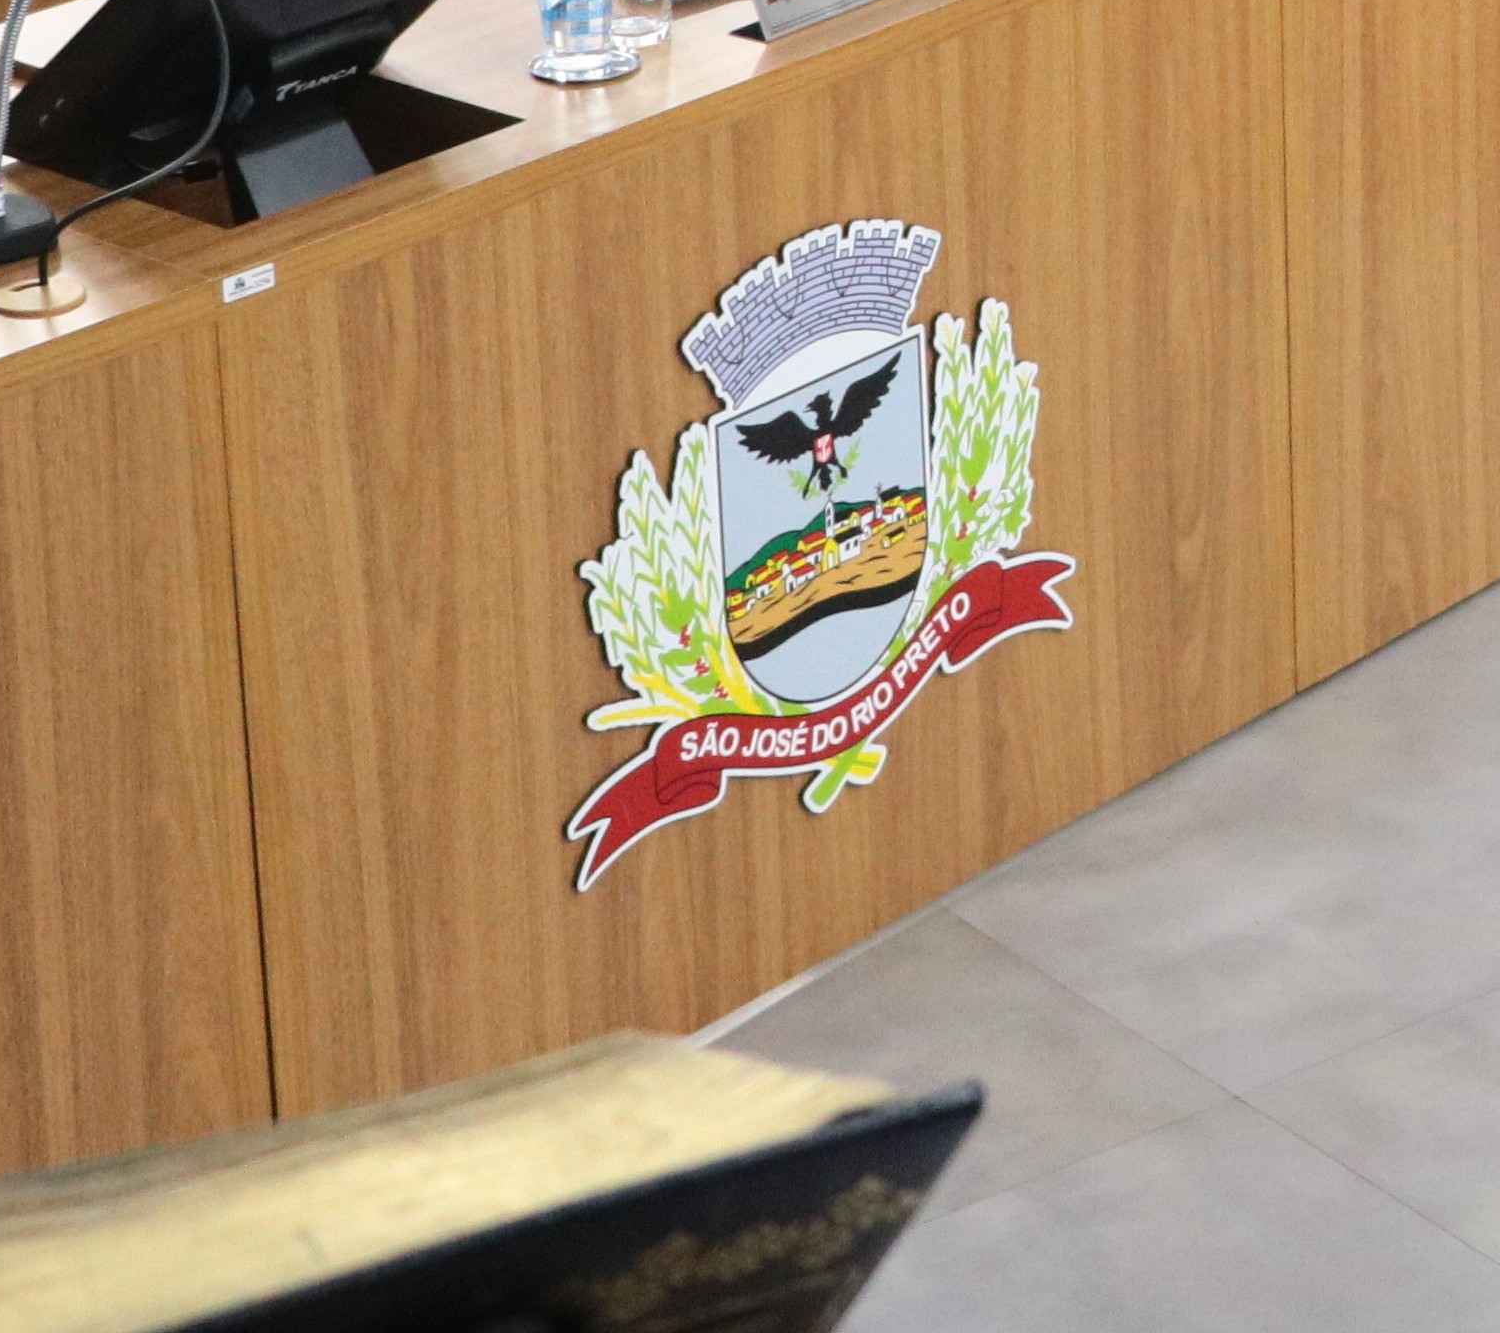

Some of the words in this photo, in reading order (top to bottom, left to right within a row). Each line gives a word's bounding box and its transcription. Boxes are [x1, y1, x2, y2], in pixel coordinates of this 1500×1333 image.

[679, 721, 740, 761] SÃO
[741, 724, 808, 758] JOSÉ
[811, 715, 848, 753] DO
[850, 680, 894, 734] RIO
[891, 591, 971, 689] PRETO
